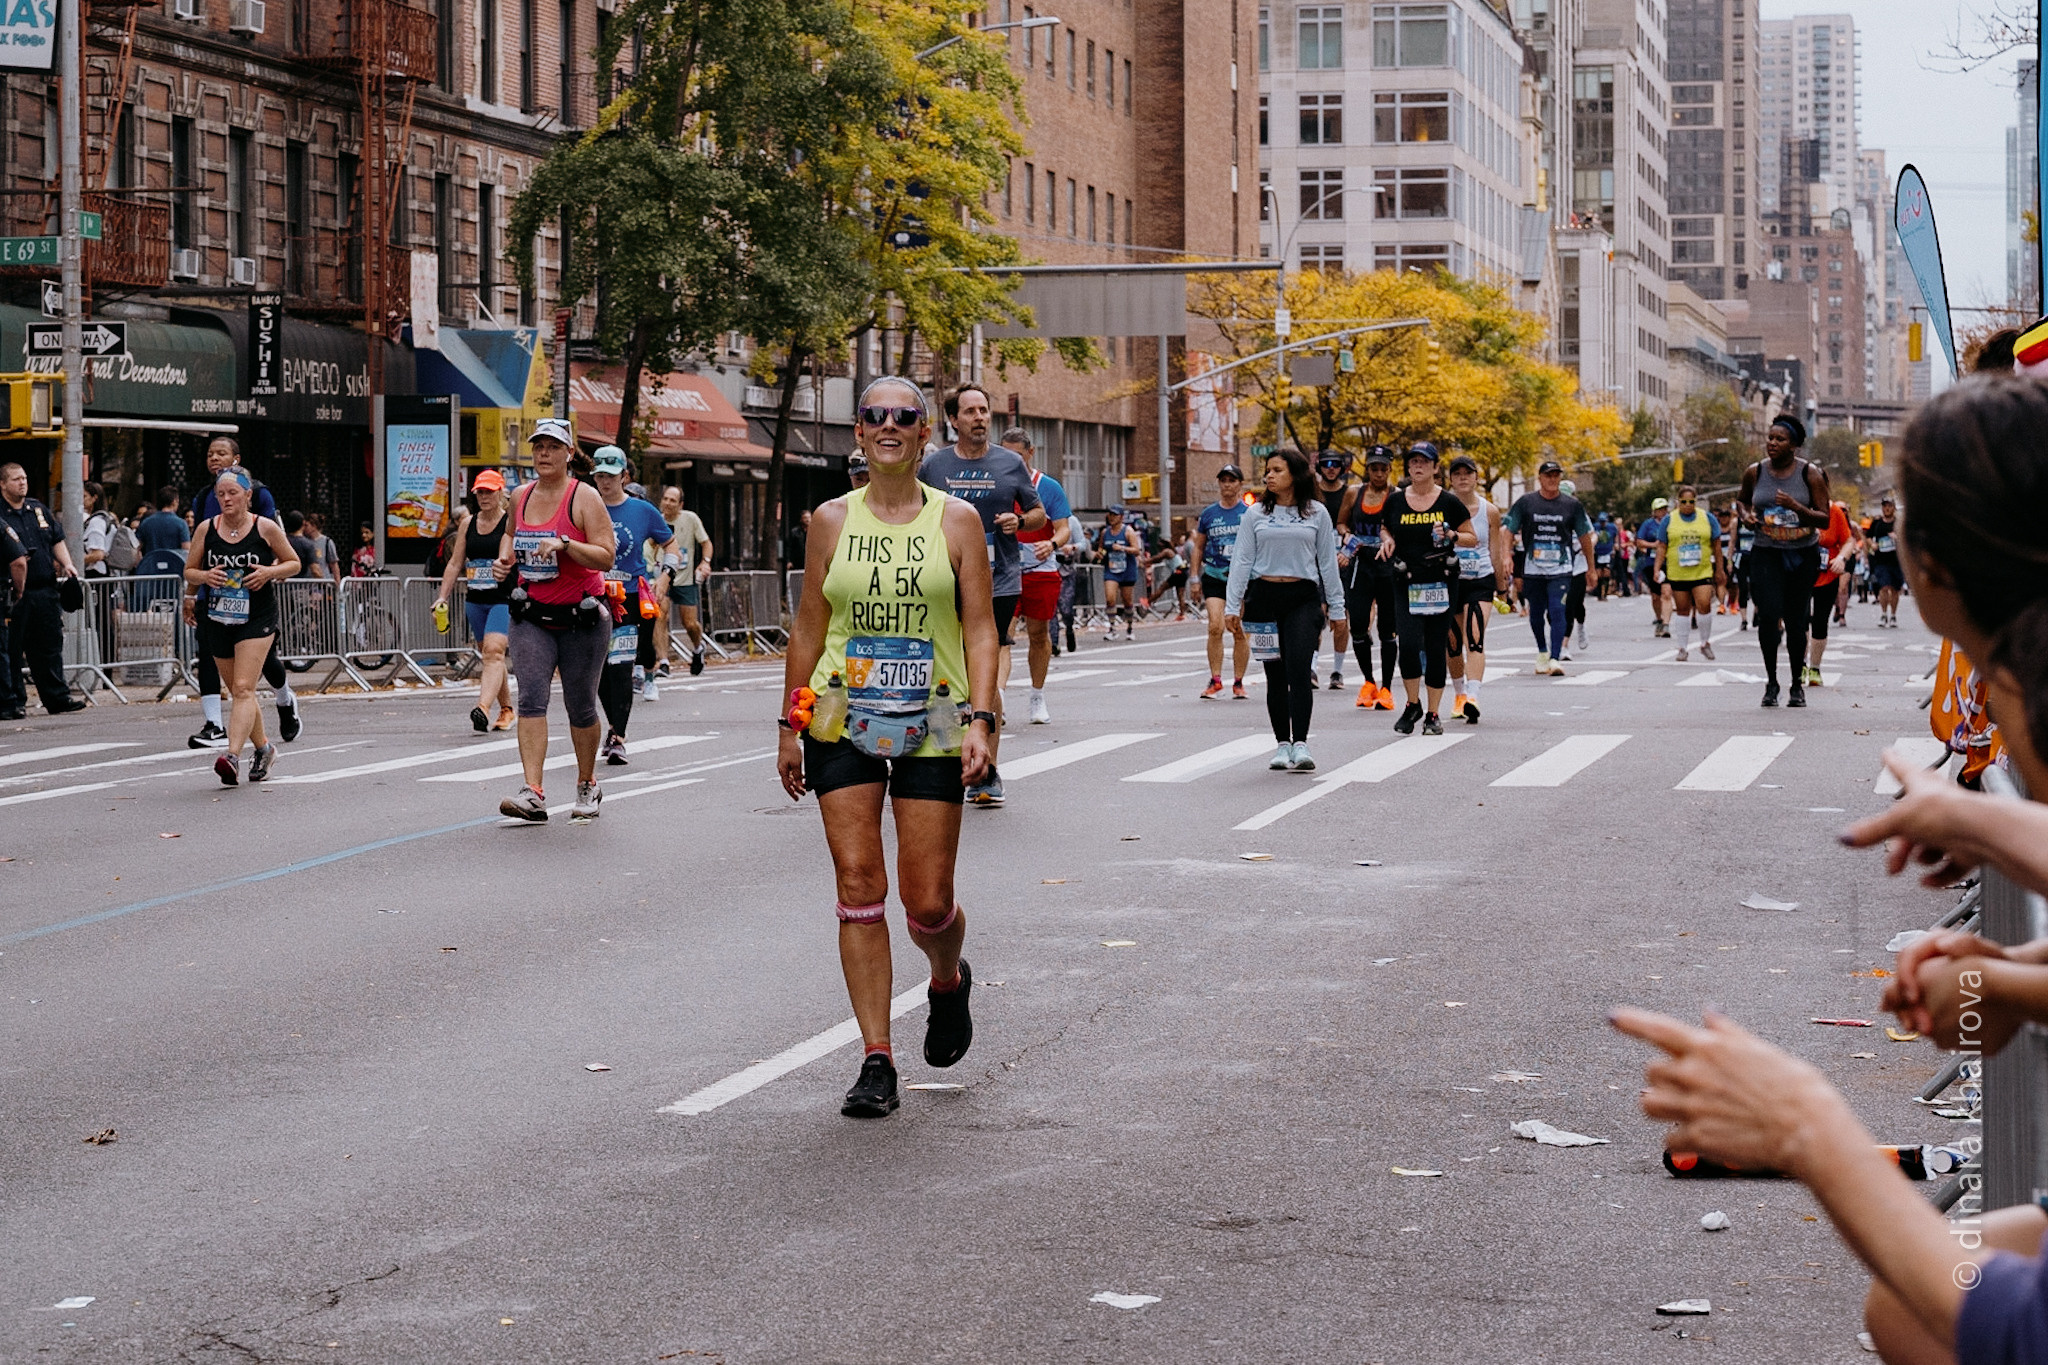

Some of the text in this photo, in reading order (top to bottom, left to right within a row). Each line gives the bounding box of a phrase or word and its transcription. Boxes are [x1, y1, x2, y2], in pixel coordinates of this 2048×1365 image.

[3, 241, 12, 261] E
[18, 241, 36, 261] 69
[42, 333, 111, 347] ON WAY
[118, 351, 188, 386] Decorators
[283, 358, 341, 396] BAMBOO
[398, 442, 436, 453] FINISH
[400, 453, 433, 463] WITH
[401, 464, 433, 475] FLAIR
[1400, 511, 1445, 525] MEAGAN
[848, 534, 926, 564] THIS IS
[867, 566, 924, 598] A 5K
[223, 599, 246, 613] 62387
[852, 601, 929, 634] RIGHT?
[855, 643, 874, 656] tcs
[880, 661, 928, 688] 57035
